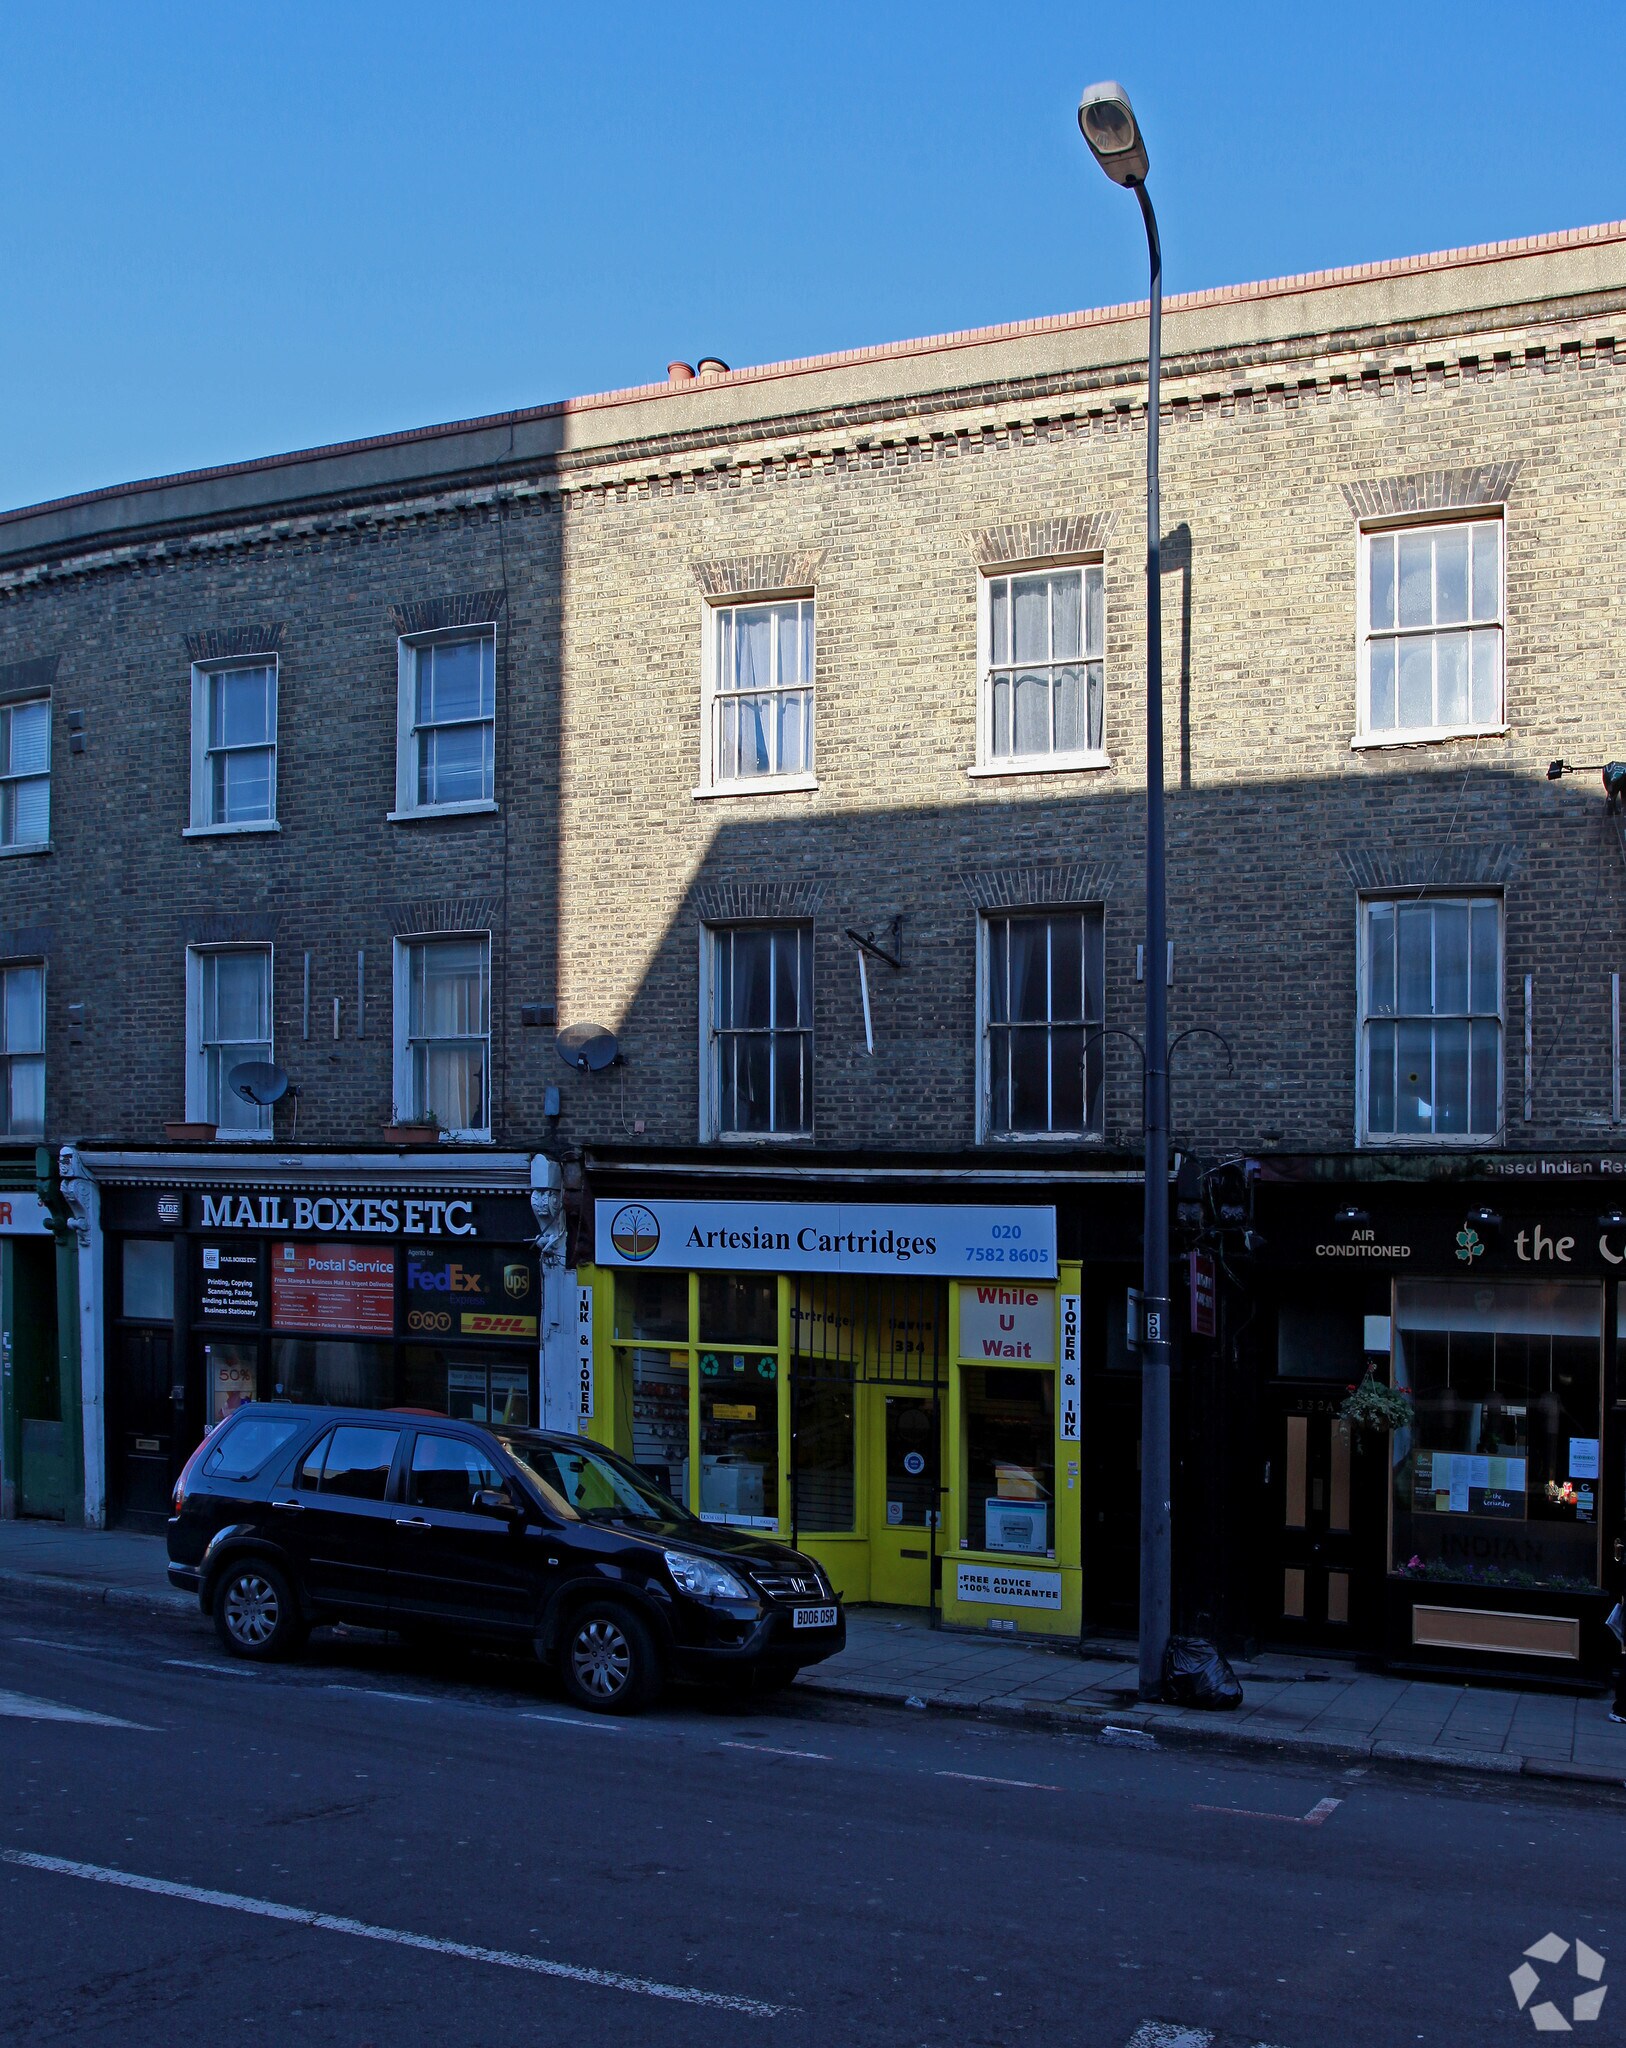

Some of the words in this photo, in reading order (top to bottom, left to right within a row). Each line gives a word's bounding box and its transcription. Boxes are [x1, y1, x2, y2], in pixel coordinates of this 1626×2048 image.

[1486, 1159, 1537, 1174] ensed
[1540, 1159, 1593, 1175] Indian
[1600, 1160, 1626, 1173] Re
[160, 1203, 179, 1214] MBE
[201, 1195, 290, 1229] MAIL
[293, 1197, 401, 1233] BOXES
[403, 1200, 478, 1235] ETC.
[991, 1225, 1021, 1239] 020
[1351, 1229, 1375, 1242] AIR
[685, 1225, 791, 1250] Artesian
[797, 1226, 937, 1261] Cartridges
[1513, 1223, 1576, 1262] the
[1598, 1233, 1626, 1264] C
[408, 1249, 425, 1257] Agents
[426, 1249, 434, 1257] for
[965, 1247, 1004, 1261] 7582
[1009, 1248, 1049, 1262] 8605
[1315, 1244, 1411, 1258] CONDITIONED
[308, 1258, 346, 1271] Postal
[348, 1259, 394, 1273] Service
[207, 1278, 231, 1287] Printing,
[231, 1279, 253, 1288] Copying
[351, 1280, 368, 1288] Urgent
[407, 1262, 481, 1292] FedEx
[207, 1288, 233, 1296] Scanning,
[234, 1289, 253, 1297] Faxing
[450, 1294, 486, 1305] Express
[977, 1287, 1039, 1306] While
[202, 1297, 222, 1305] Binding
[228, 1299, 259, 1307] Laminating
[580, 1289, 589, 1323] INK
[228, 1308, 257, 1317] Stationary
[409, 1312, 450, 1330] TNT
[471, 1316, 527, 1331] DHL
[999, 1314, 1015, 1331] U
[1064, 1298, 1077, 1361] TONER
[580, 1334, 589, 1346] &
[982, 1339, 1032, 1358] Wait
[219, 1368, 251, 1381] 50%
[1064, 1374, 1076, 1386] &
[580, 1357, 590, 1414] TONER
[1064, 1399, 1076, 1436] INK
[993, 1576, 1031, 1588] ADVICE
[994, 1586, 1058, 1599] GUARANTEE
[797, 1610, 819, 1625] BD06
[820, 1609, 835, 1623] OSR
